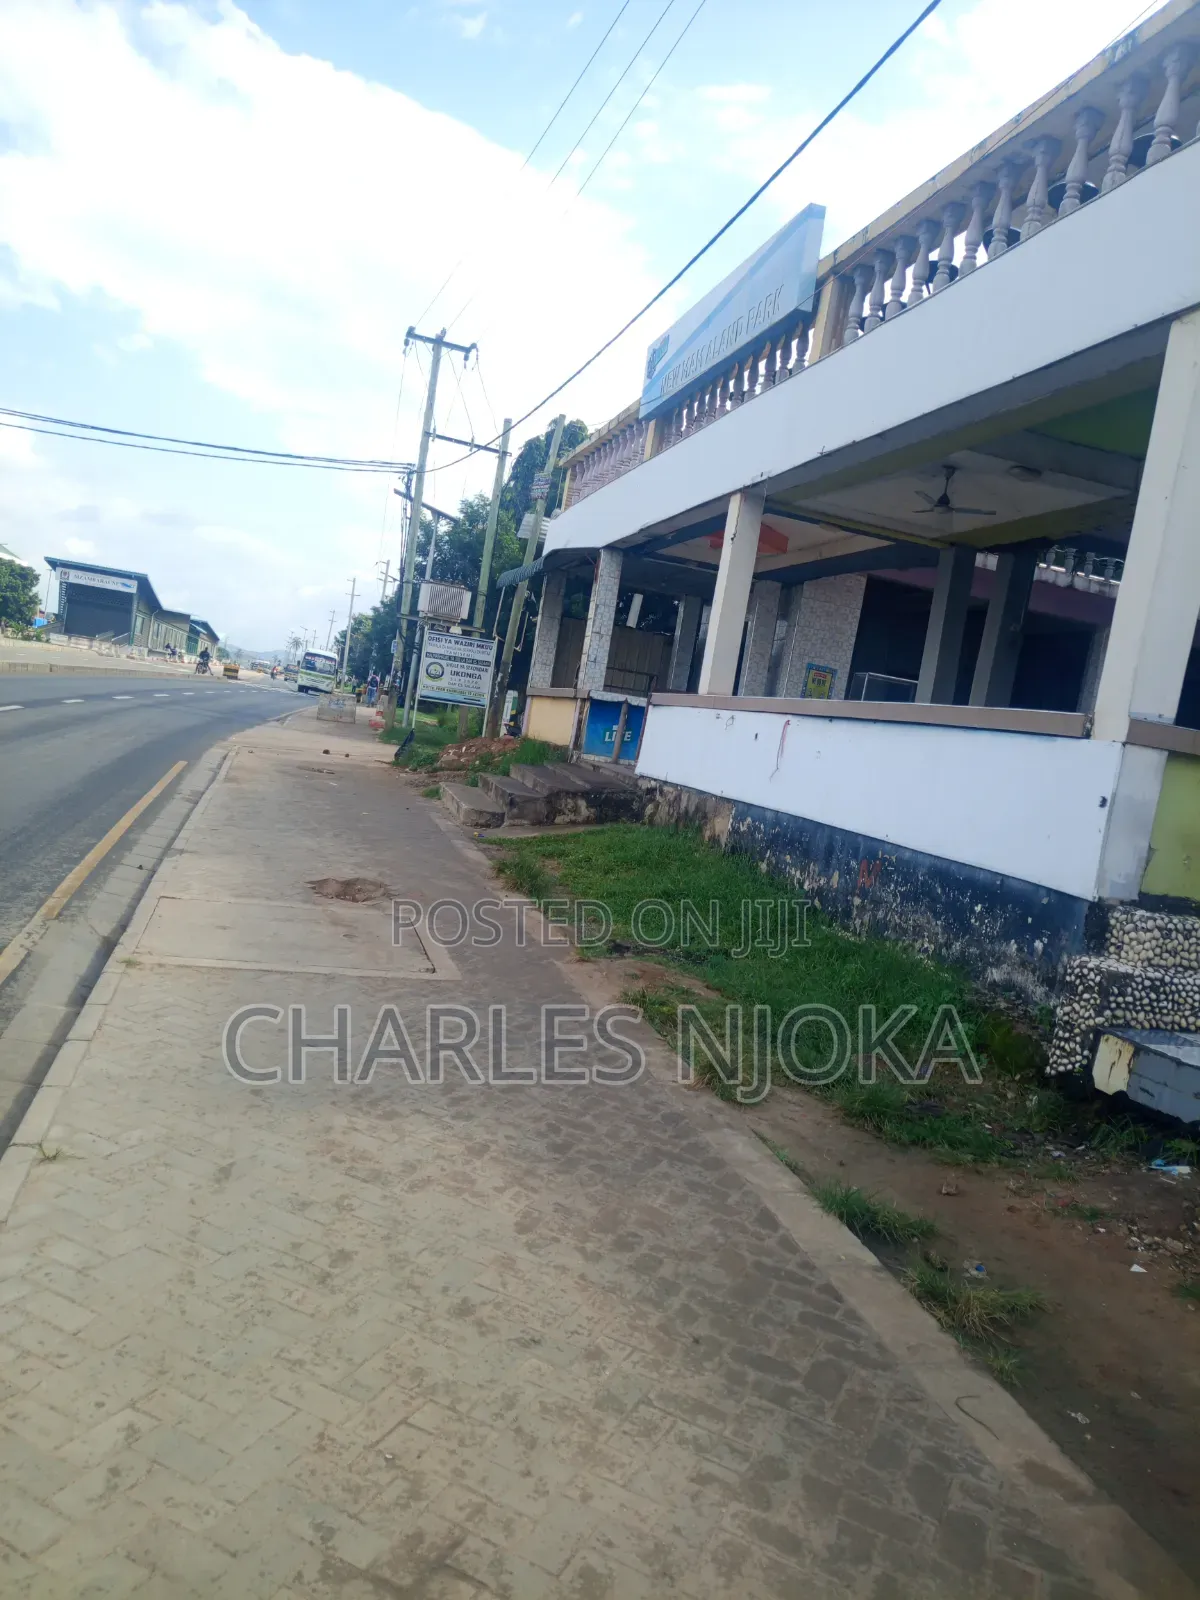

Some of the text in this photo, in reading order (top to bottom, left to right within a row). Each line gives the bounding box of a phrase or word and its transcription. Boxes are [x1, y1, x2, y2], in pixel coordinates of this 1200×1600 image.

[746, 284, 785, 334] PARK
[454, 639, 475, 648] WAZIRI
[476, 643, 493, 651] MKUU
[450, 670, 482, 680] UKONGA
[604, 731, 632, 742] LIE
